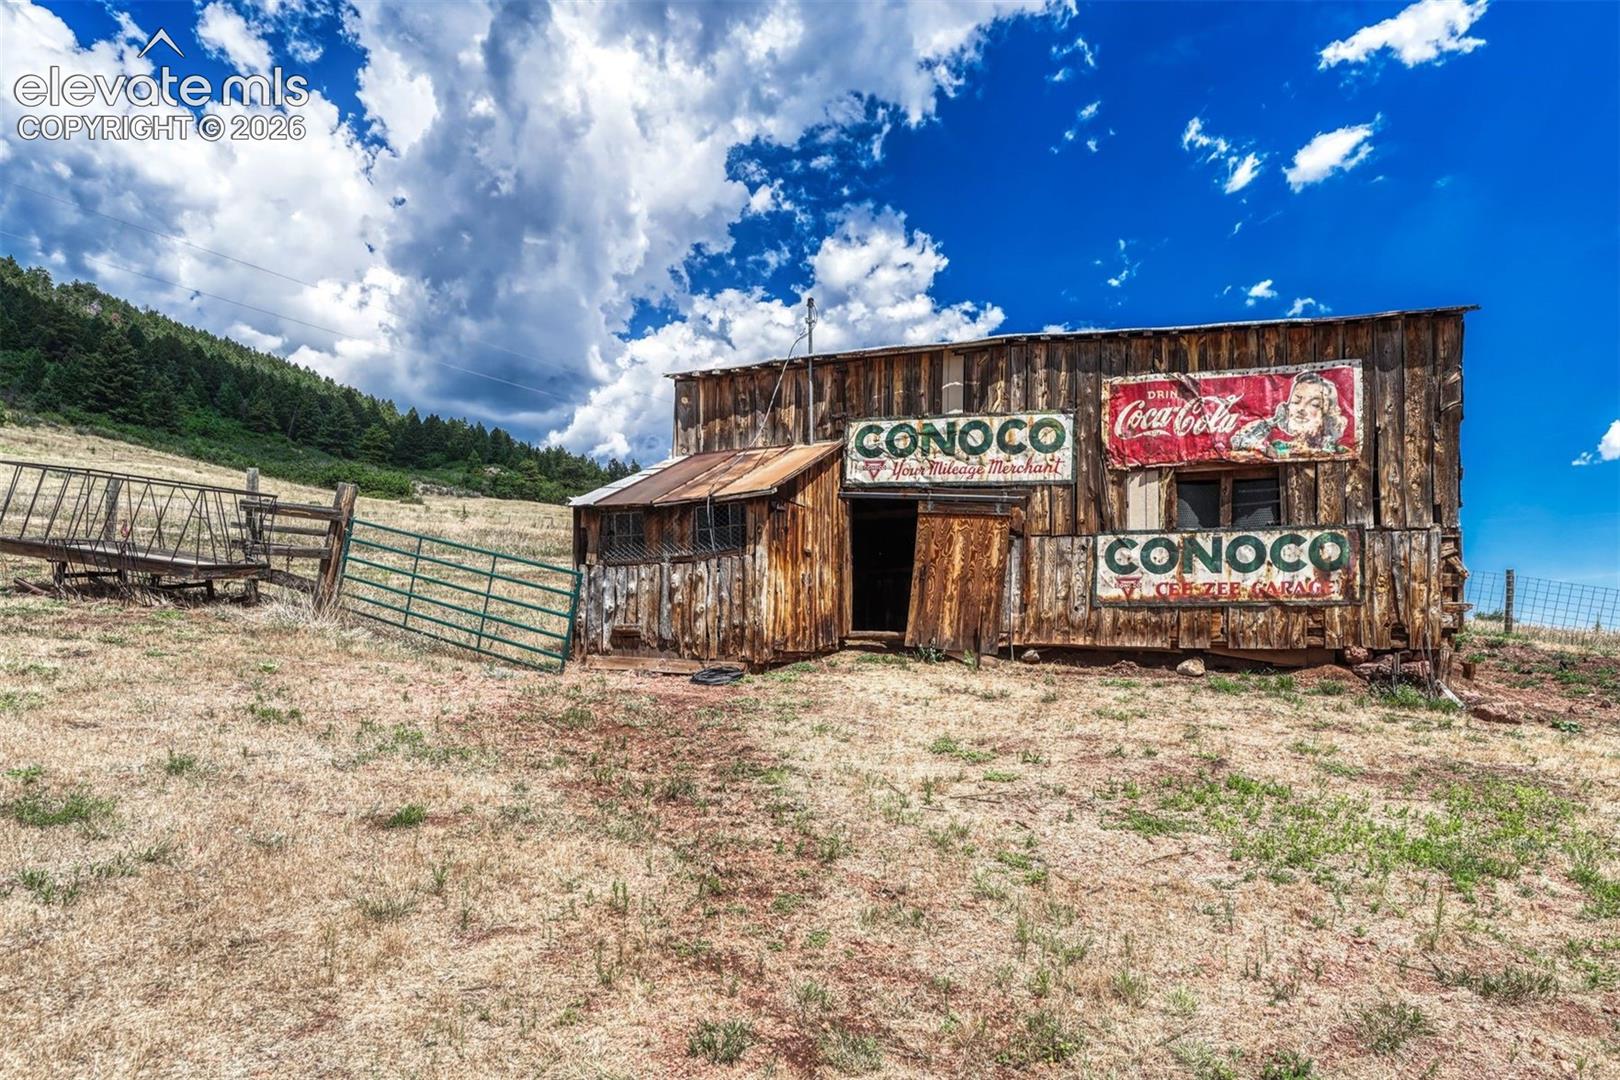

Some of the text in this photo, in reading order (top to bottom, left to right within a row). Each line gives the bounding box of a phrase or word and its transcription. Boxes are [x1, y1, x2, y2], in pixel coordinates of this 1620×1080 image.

[1147, 390, 1178, 399] DRIN
[854, 417, 1067, 459] CONOCO
[892, 456, 1065, 481] Your Mileage Merchant
[1104, 531, 1348, 575] CONOCO
[1204, 582, 1241, 597] ZEE
